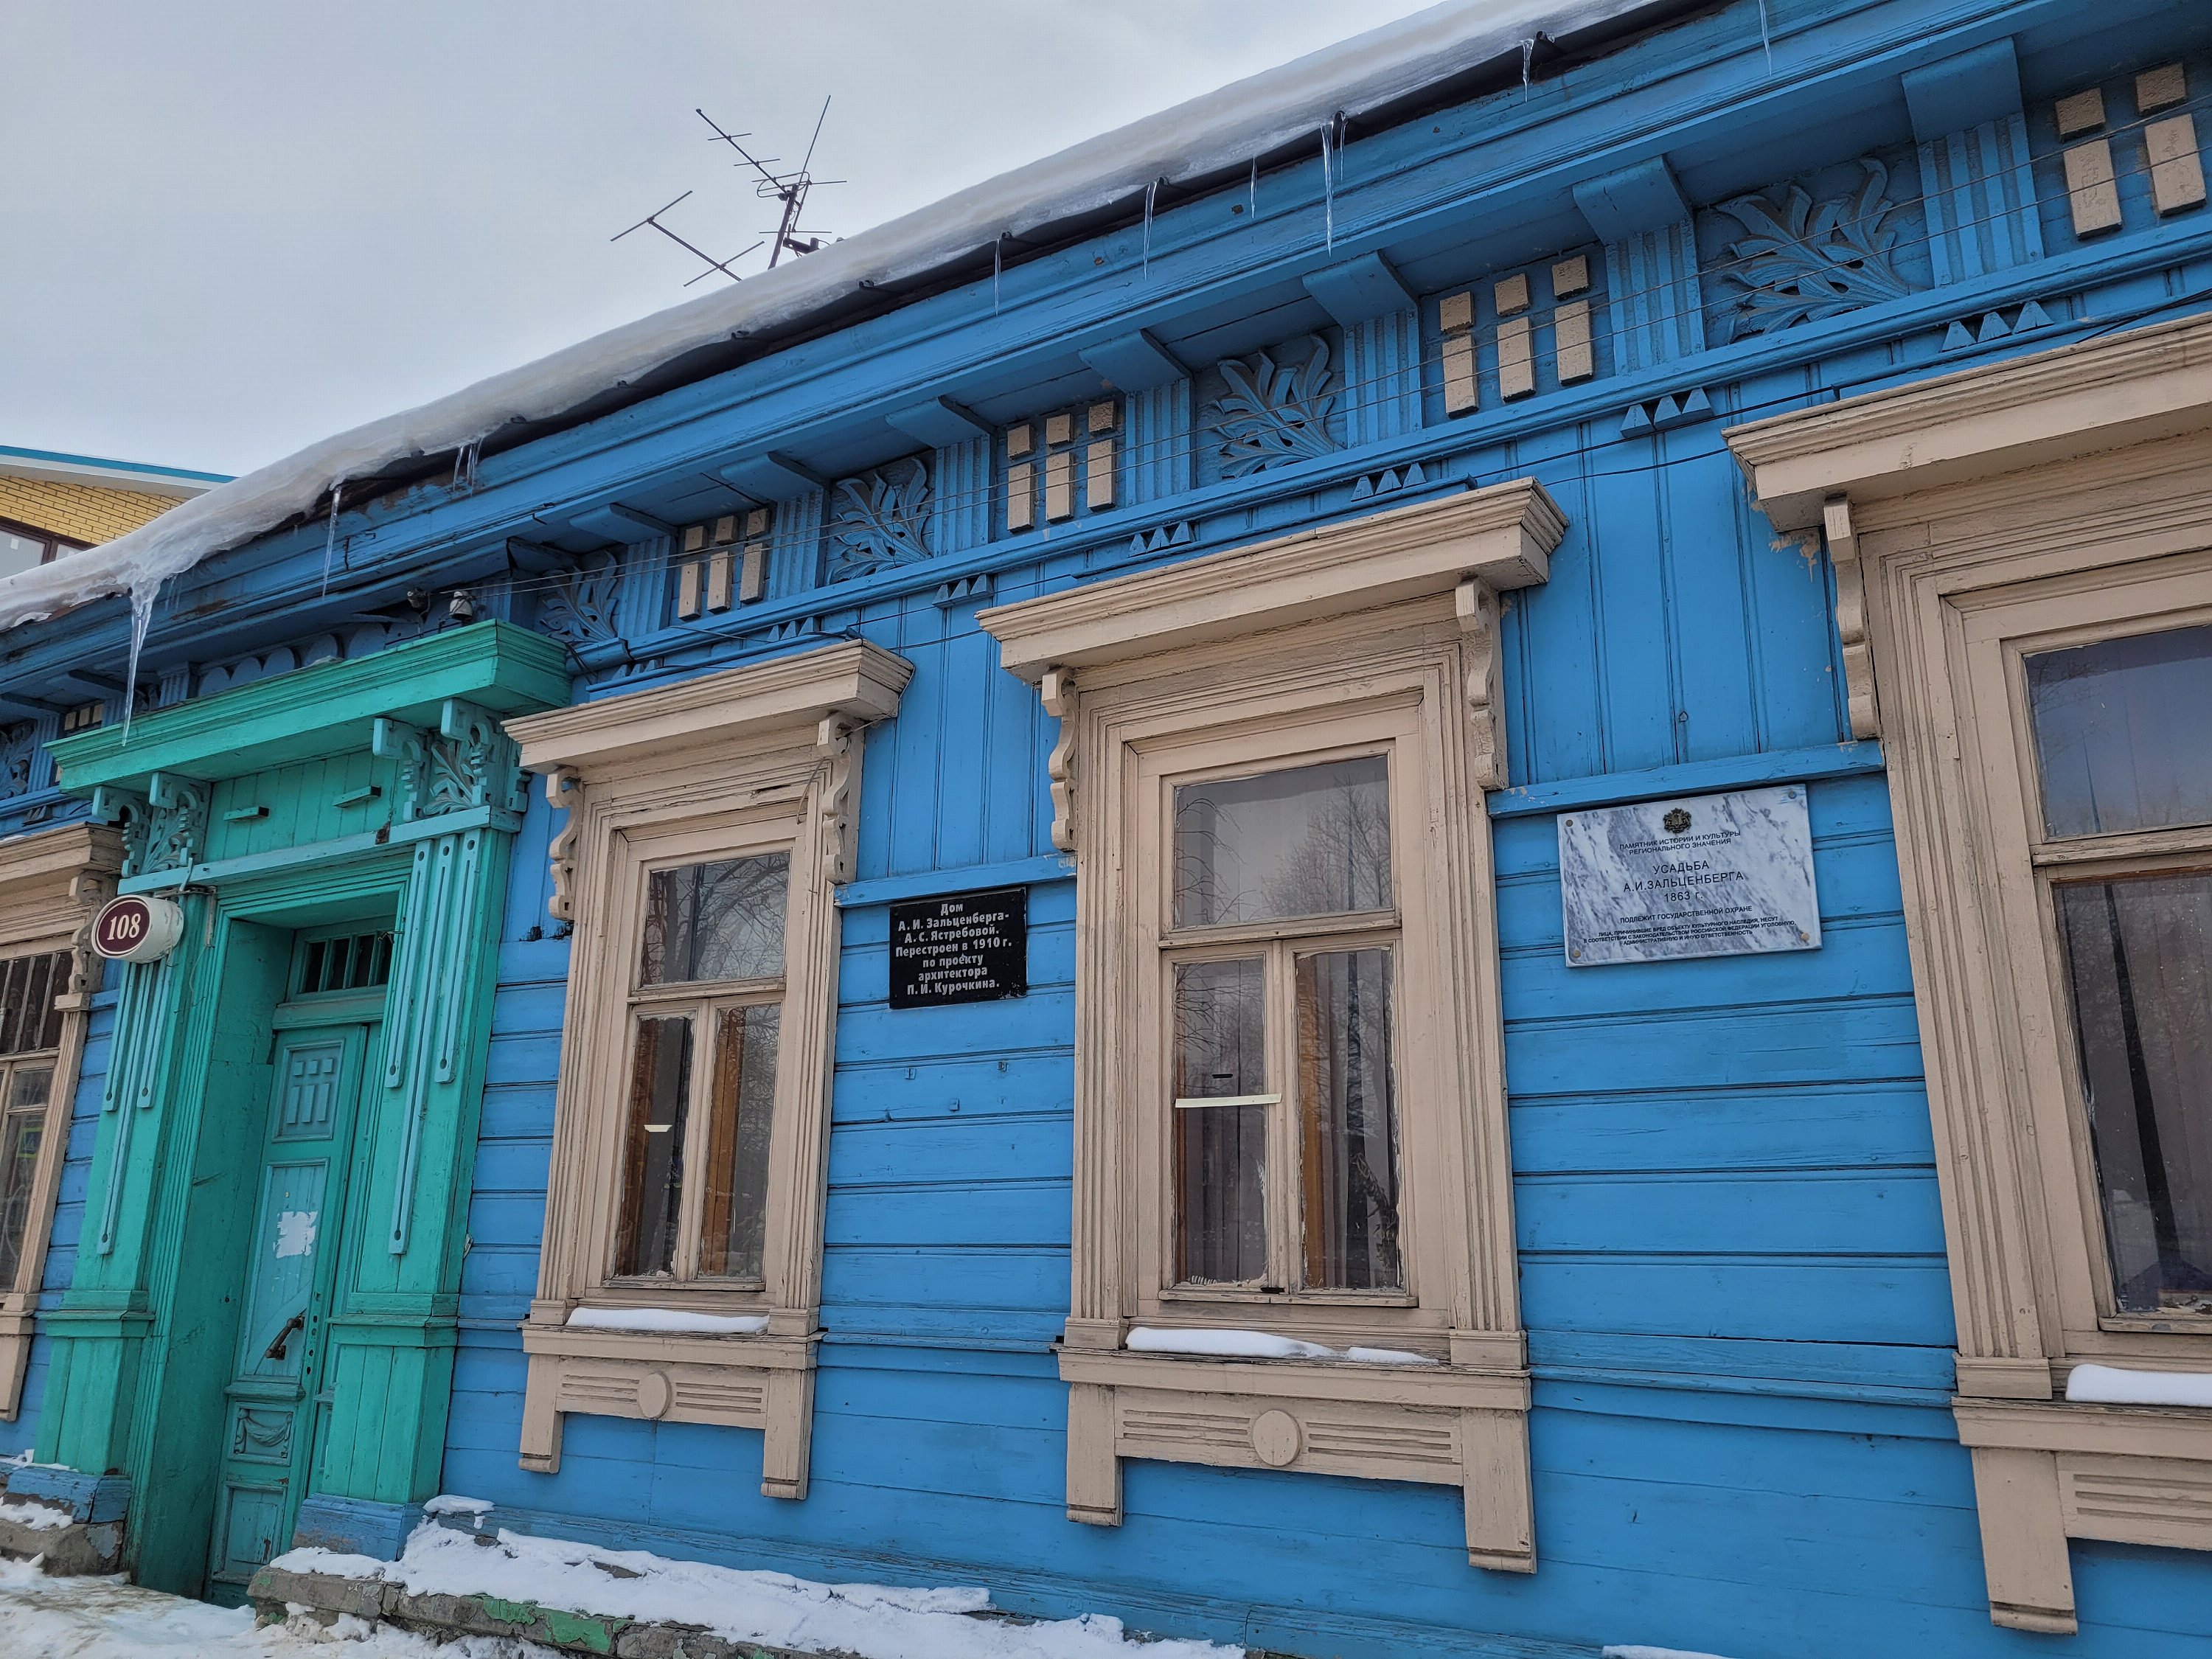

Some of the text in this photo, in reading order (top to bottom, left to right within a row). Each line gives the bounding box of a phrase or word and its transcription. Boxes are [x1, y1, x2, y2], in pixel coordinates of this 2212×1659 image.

[1620, 840, 1658, 849] ПАМЯТНИК
[1659, 835, 1694, 846] ИСТОРИИ
[1703, 830, 1741, 840] КУЛЬТУРЫ
[1629, 838, 1731, 855] РЕГИОНАЛЬНОГО ЗНАЧЕНИЯ
[1652, 860, 1710, 875] УСАДЬБА
[1623, 871, 1745, 893] А.И.ЗАЛЬЦЕНБЕРГА
[1663, 891, 1691, 902] 1863
[940, 903, 964, 916] Дом
[1620, 905, 1753, 923] ПОДЛЕЖИТ ГОСУДАРСТВЕННОЙ ОХРАНЕ
[107, 913, 141, 941] 108
[898, 911, 1009, 931] А. И. Зальценберга-
[1614, 928, 1652, 936] ПРИЧИНИВШИЕ
[1691, 921, 1728, 929] КУЛЬТУРНОГО
[904, 924, 999, 944] А. С. Ястребовой.
[1588, 935, 1627, 943] СООТВЕТСТВИИ
[1632, 930, 1689, 939] ЗАКОНОДАТЕЛЬСТВОМ
[1691, 925, 1726, 933] РОССИЙСКОЙ
[1624, 936, 1678, 945] АДМИНИСТРАТИВНУЮ
[1700, 930, 1753, 938] ОТВЕТСТВЕННОСТЬ
[896, 936, 1012, 958] Перестроен в 1910 г.
[922, 954, 984, 969] по проекту
[918, 967, 988, 983] архитектора
[907, 978, 1000, 995] П. И. Курочкина.
